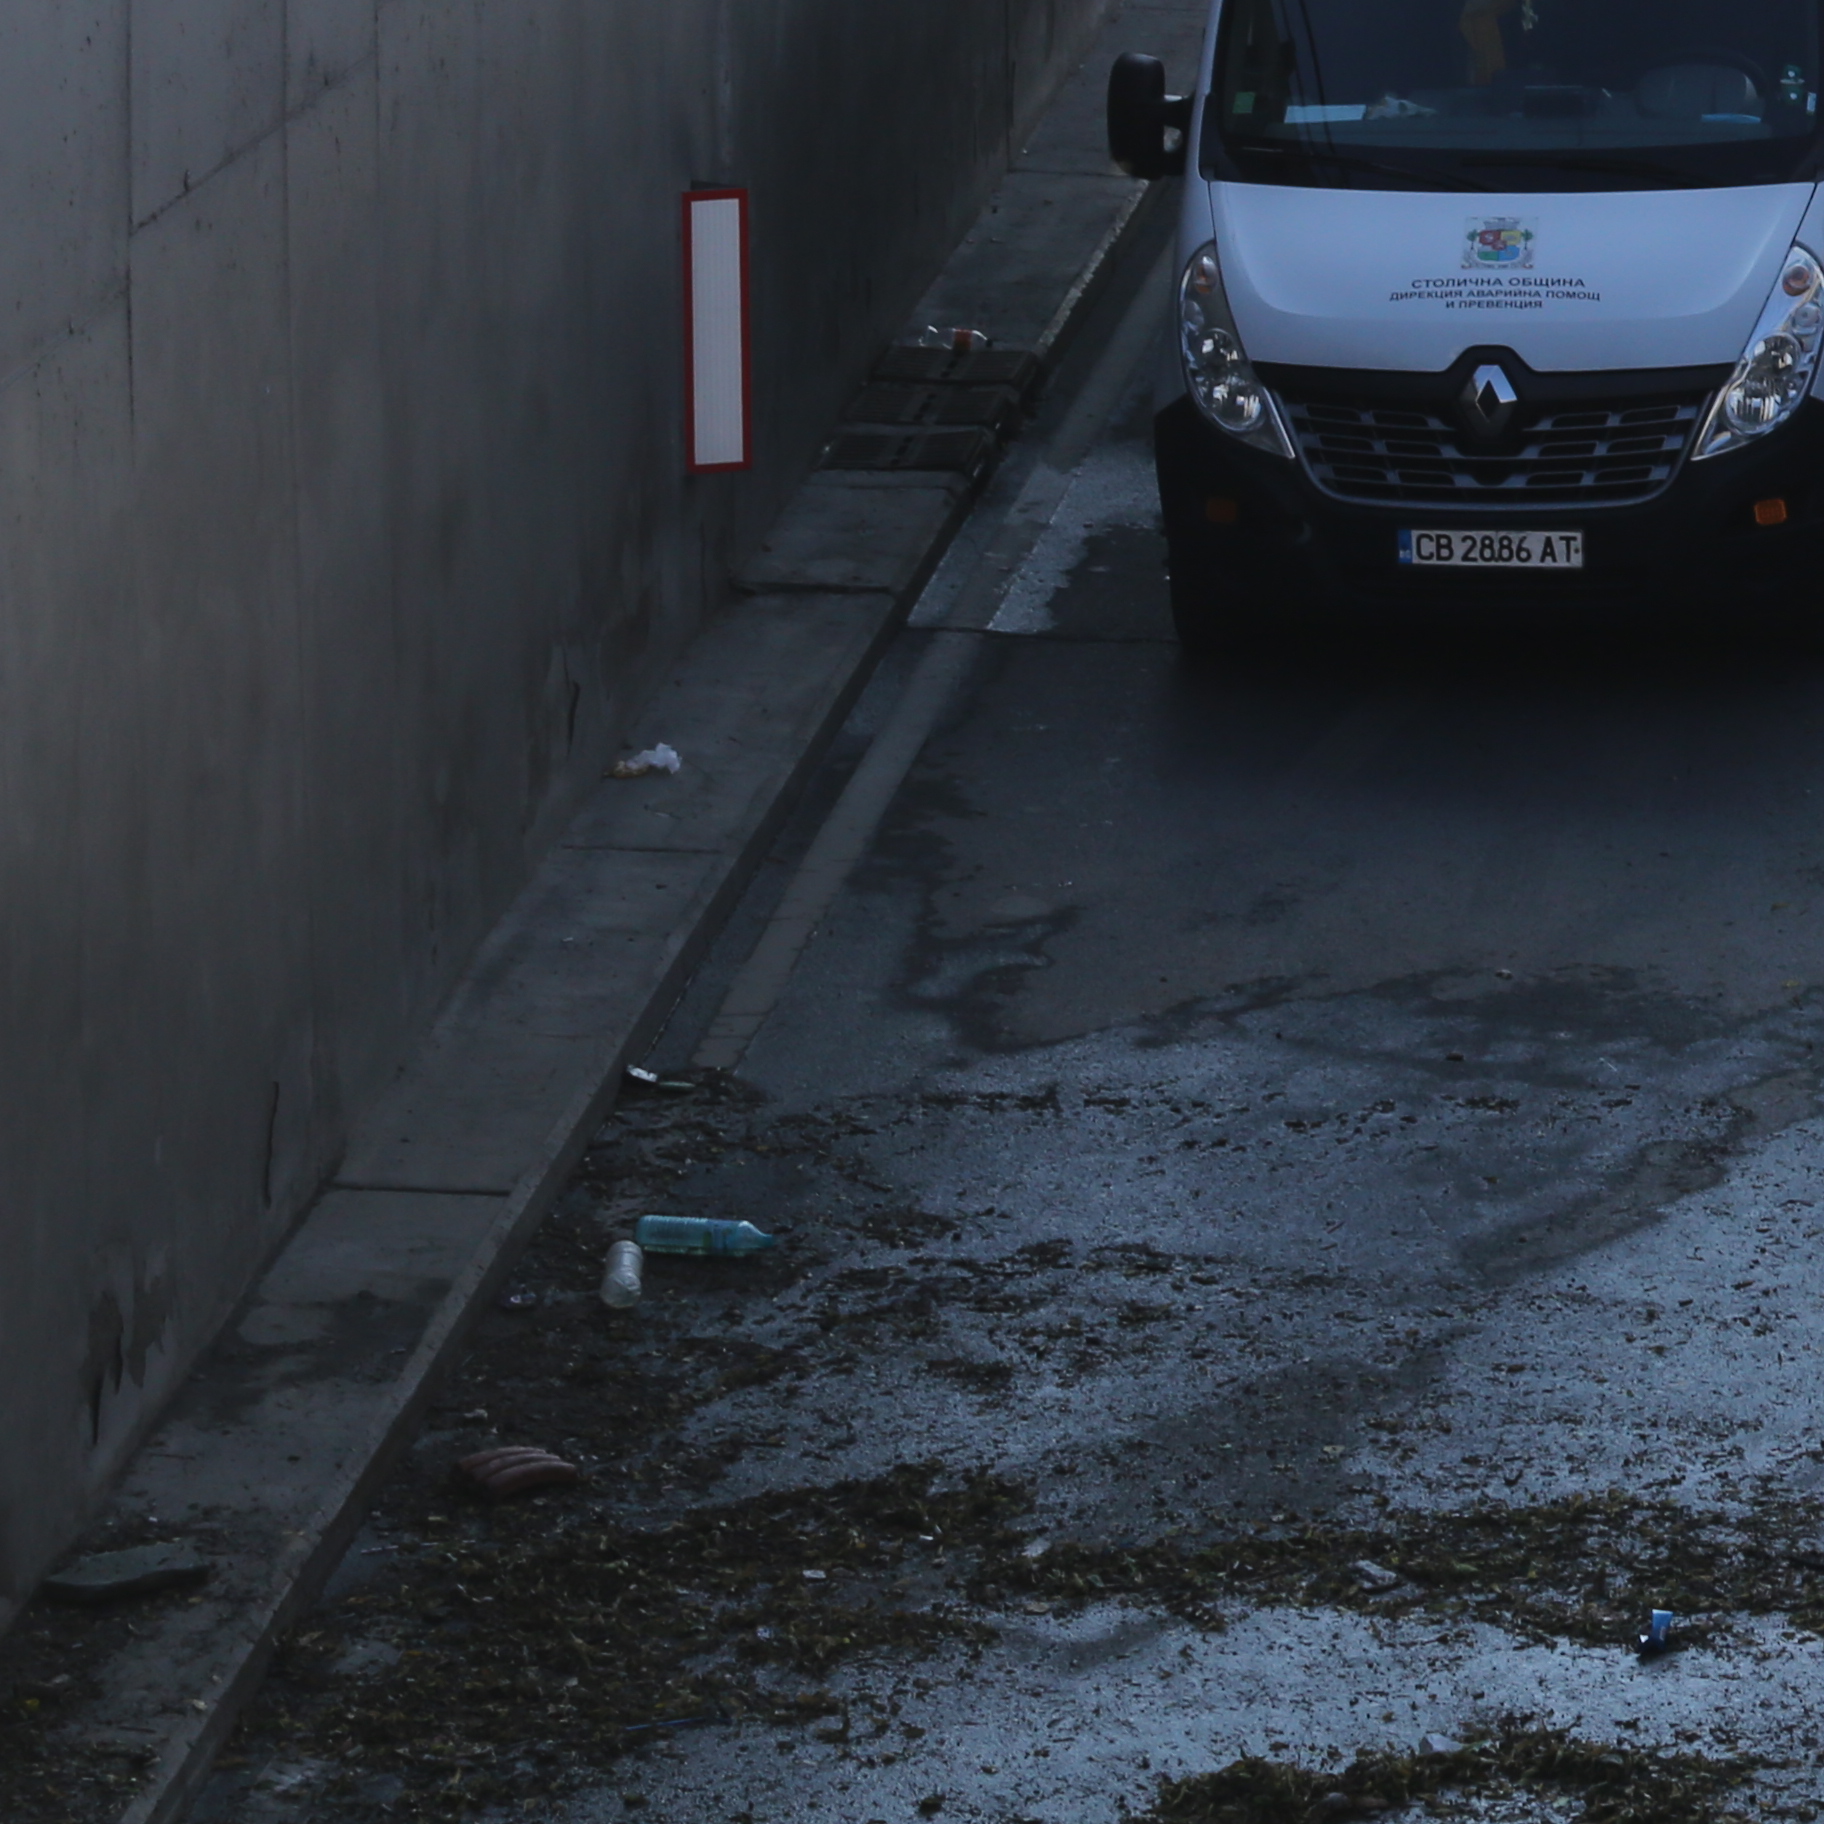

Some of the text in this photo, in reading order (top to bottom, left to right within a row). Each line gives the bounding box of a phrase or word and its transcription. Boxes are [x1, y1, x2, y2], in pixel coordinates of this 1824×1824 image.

[1411, 277, 1585, 289] СТОЛИЧНА ОБЩИНА
[1389, 288, 1600, 302] ДИРЕКЦИЯ АВАРИЙНА ПОМОЩ
[1445, 300, 1543, 310] И ПРЕВЕНЦИЯ
[1461, 534, 1532, 563] 2886
